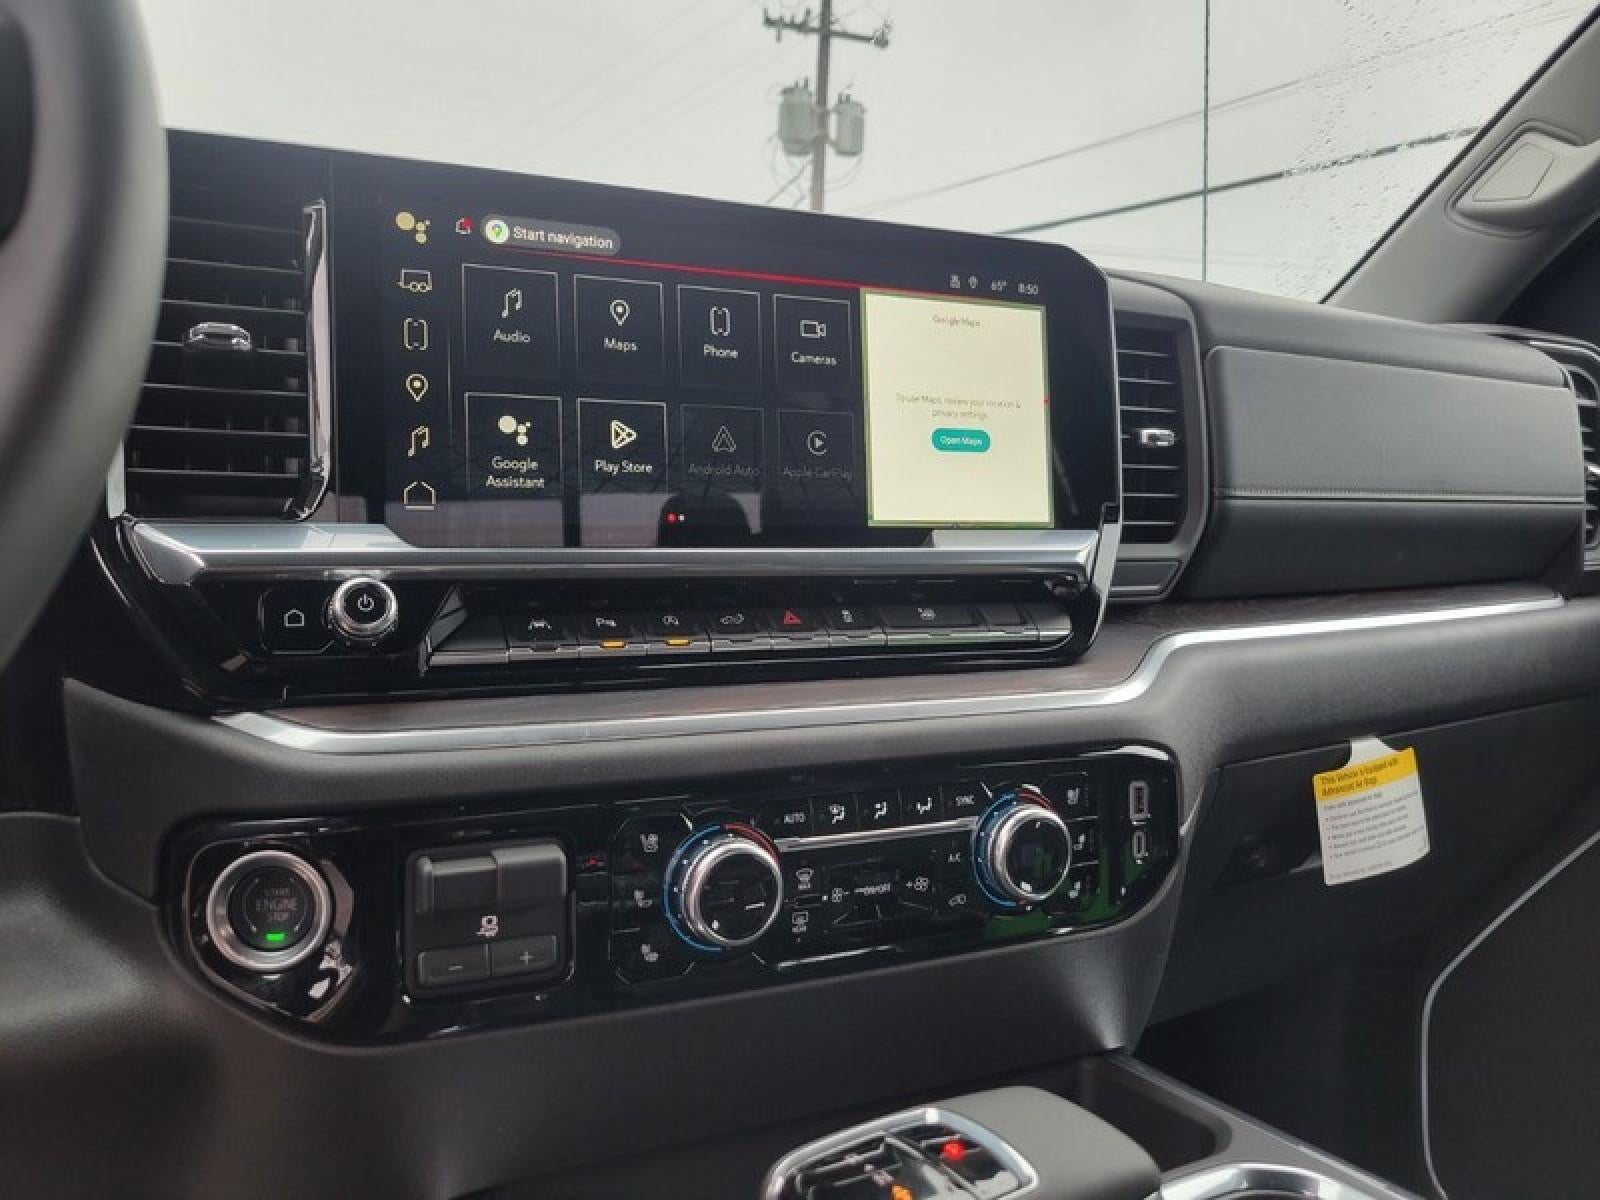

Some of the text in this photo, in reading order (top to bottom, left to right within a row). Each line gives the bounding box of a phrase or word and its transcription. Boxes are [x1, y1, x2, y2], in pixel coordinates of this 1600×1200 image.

[513, 226, 614, 250] Start navigation
[493, 328, 531, 345] Audio
[604, 337, 638, 352] Maps
[703, 345, 739, 360] Phone
[791, 351, 837, 367] Cameras
[491, 455, 539, 473] Google
[595, 459, 653, 475] Play Store
[485, 474, 545, 490] Assistant
[783, 812, 806, 825] AUTO
